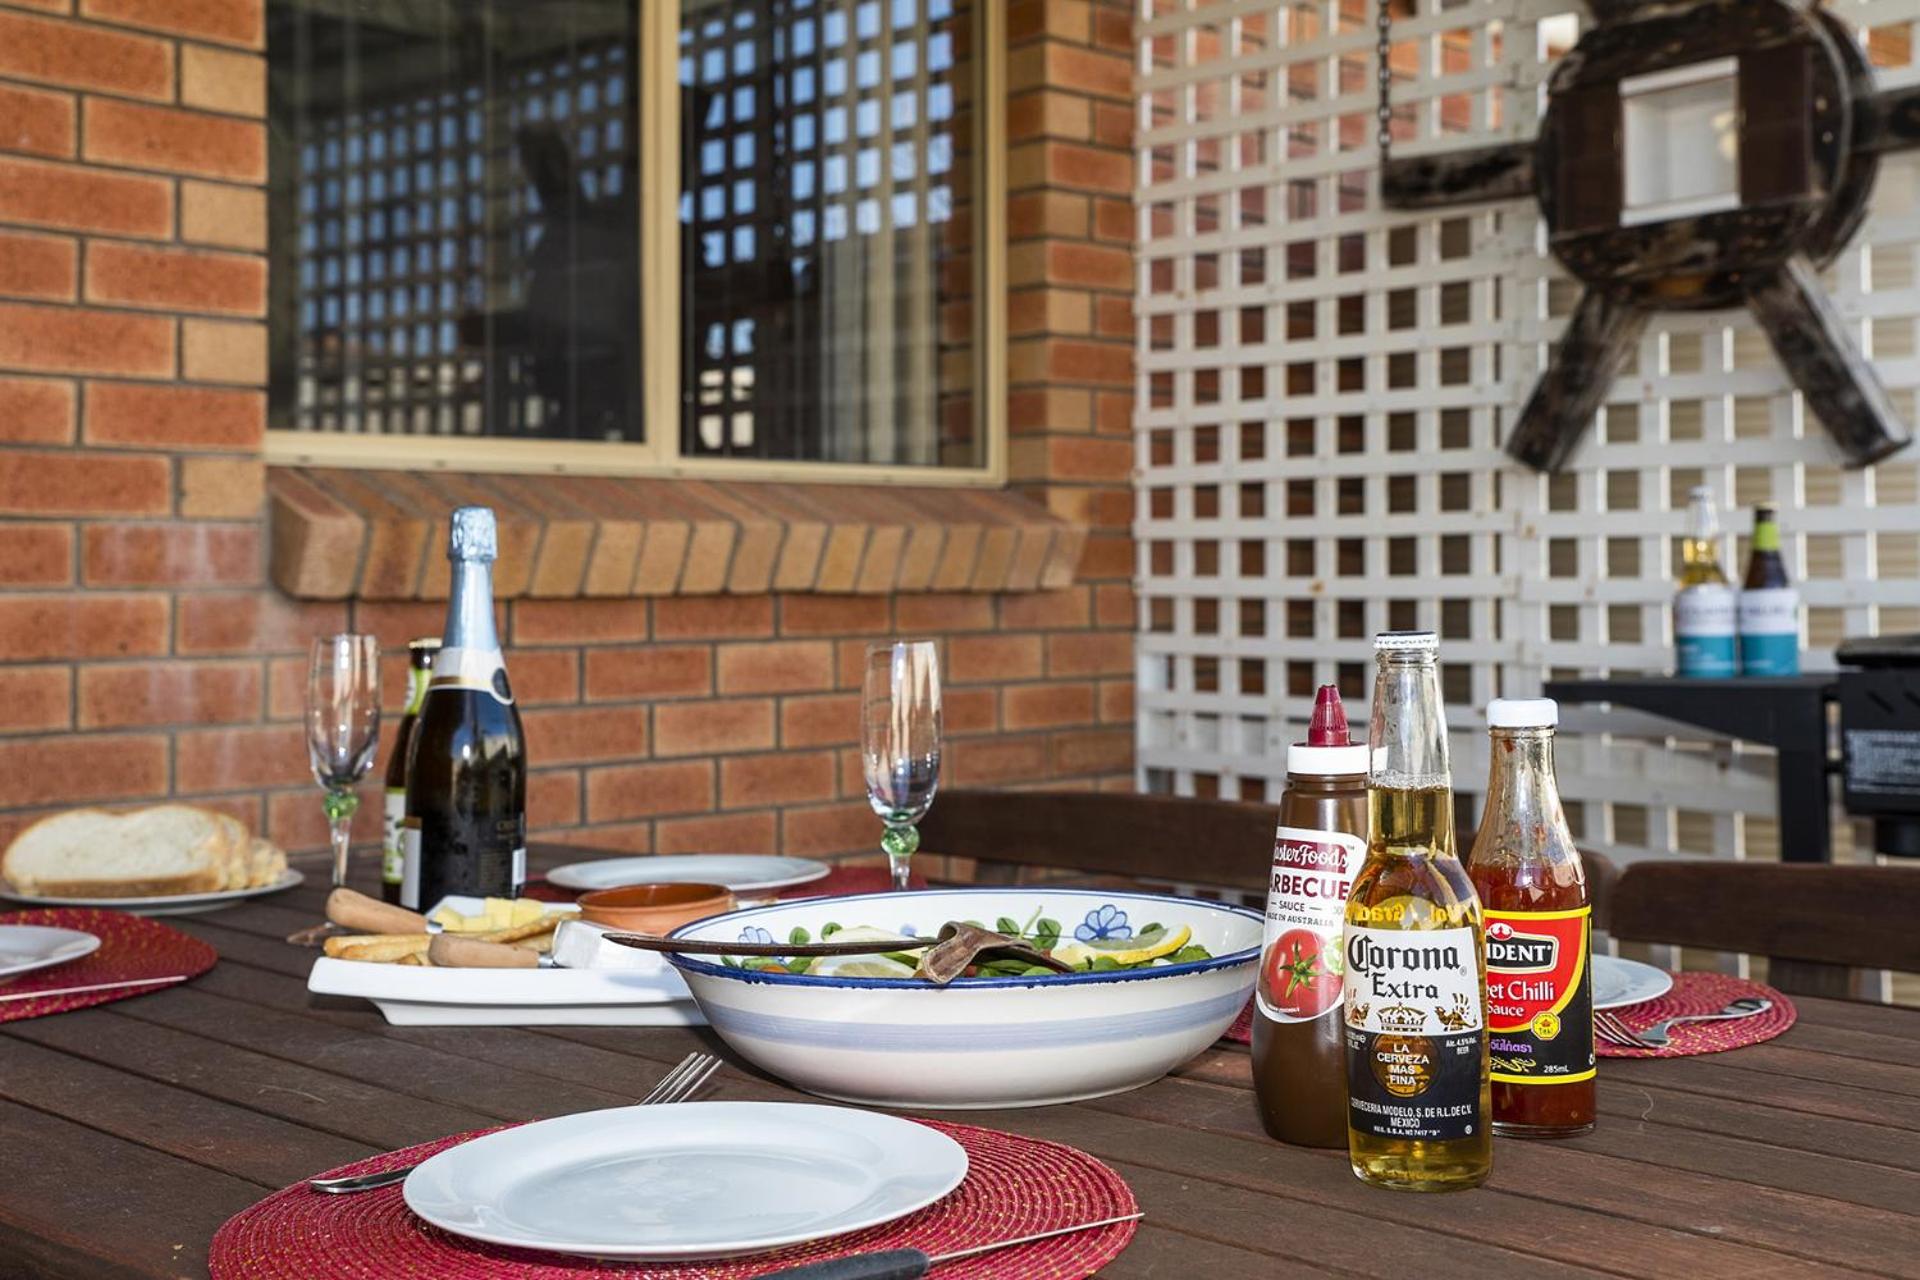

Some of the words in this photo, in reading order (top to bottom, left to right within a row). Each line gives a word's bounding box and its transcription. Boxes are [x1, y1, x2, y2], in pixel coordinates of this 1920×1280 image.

[1274, 844, 1350, 868] asterFoods
[1271, 874, 1350, 900] RBECUE
[1279, 900, 1305, 912] SAUCE
[1287, 915, 1334, 927] AUSTRALIA
[1347, 934, 1461, 978] Corona
[1486, 942, 1546, 962] IDENT
[1371, 972, 1439, 999] Extra
[1507, 980, 1554, 1001] Chilli
[1487, 1000, 1525, 1017] Sauce
[1393, 1043, 1410, 1053] LA
[1376, 1052, 1430, 1065] CERVEZA
[1391, 1064, 1416, 1075] MAS
[1543, 1064, 1570, 1074] 285mL
[1389, 1075, 1417, 1085] FINA
[1425, 1107, 1436, 1118] DE
[1390, 1117, 1421, 1129] MEXICO
